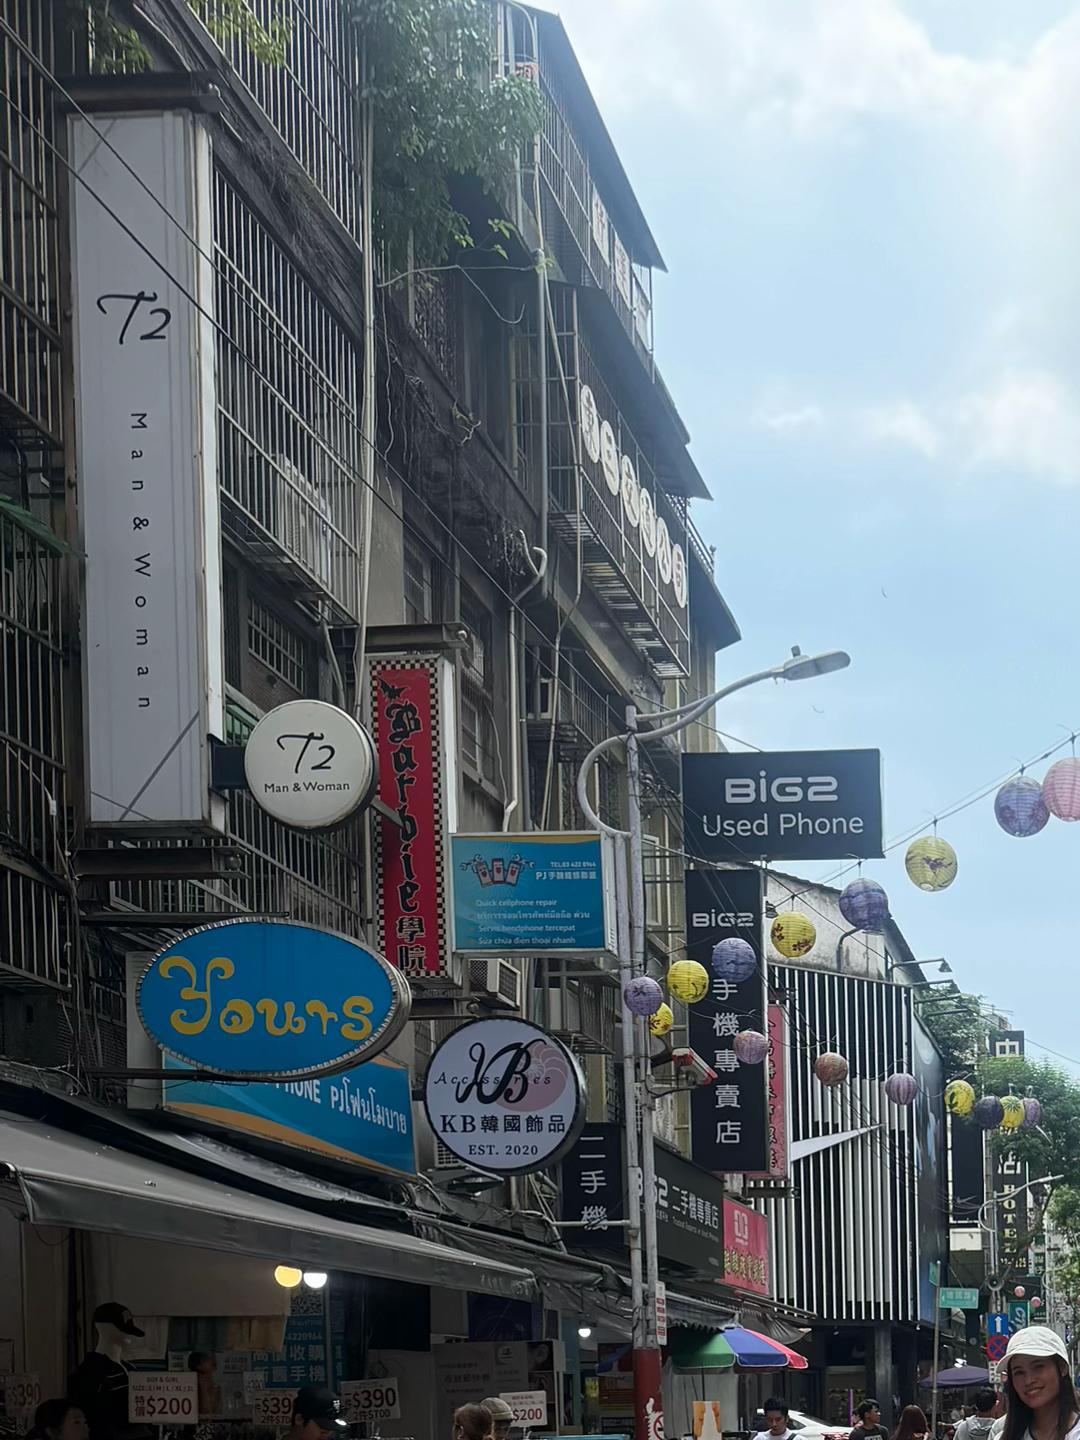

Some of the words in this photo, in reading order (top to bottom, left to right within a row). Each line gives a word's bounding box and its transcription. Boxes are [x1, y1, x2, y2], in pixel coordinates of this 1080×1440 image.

[264, 782, 289, 794] Man
[293, 782, 302, 793] &
[303, 781, 350, 793] Woman
[703, 813, 769, 837] Used
[780, 812, 864, 836] Phone
[396, 918, 426, 972] 學院
[159, 955, 374, 1041] Yours
[712, 978, 742, 1145] 手機專賣店
[468, 1145, 499, 1156] EST.
[505, 1145, 538, 1156] 2020
[580, 1136, 608, 1232] 二手機
[1002, 1184, 1017, 1254] HOTEL
[146, 1396, 192, 1417] $200
[262, 1396, 292, 1416] $39
[353, 1387, 396, 1410] $390
[512, 1408, 543, 1422] $200
